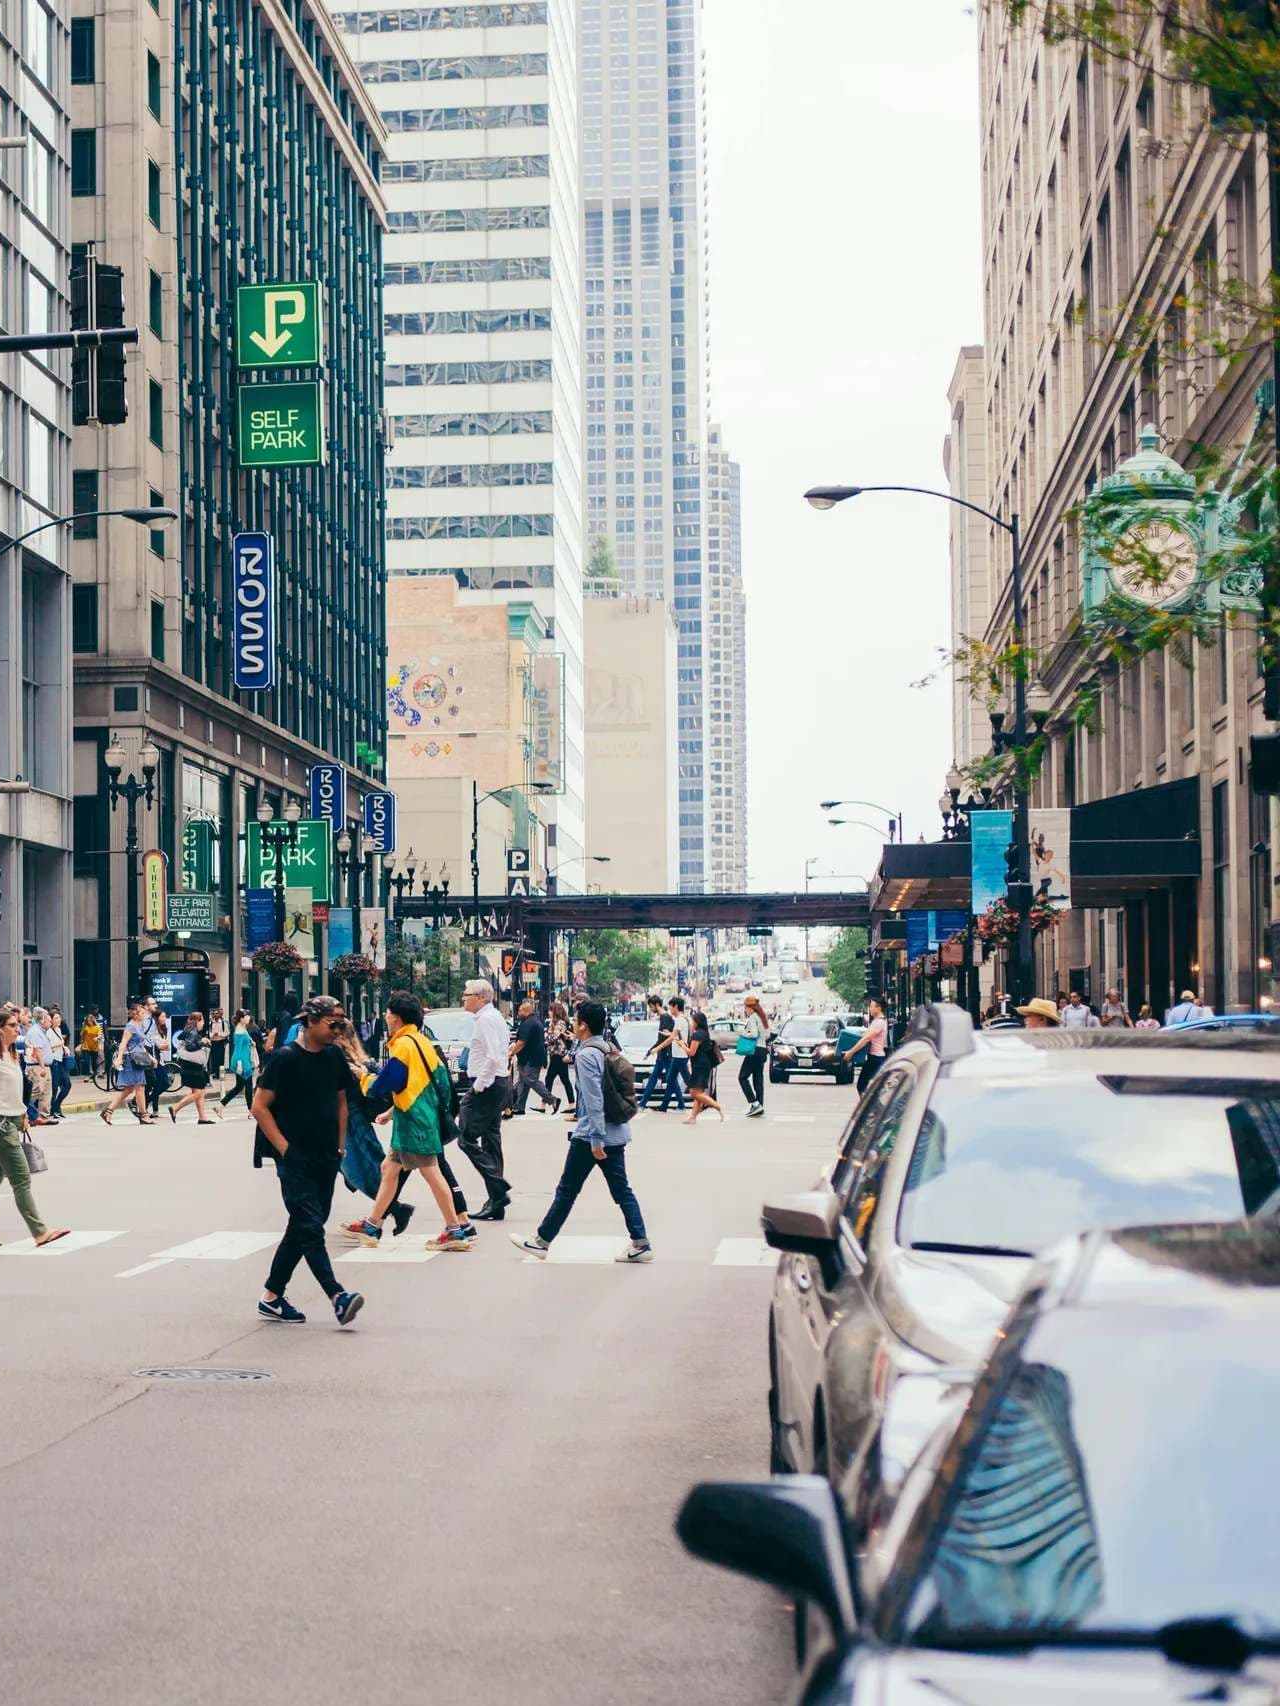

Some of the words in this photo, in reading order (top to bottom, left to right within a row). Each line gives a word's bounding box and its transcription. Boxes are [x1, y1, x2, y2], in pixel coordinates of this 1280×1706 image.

[250, 409, 300, 429] SELF
[250, 429, 307, 450] PARK
[237, 547, 266, 674] ROSS
[372, 796, 386, 851] ROSS
[259, 847, 317, 866] PARK
[169, 898, 191, 907] SELF
[192, 898, 211, 907] PARK
[171, 908, 210, 917] ELEVATOR
[169, 918, 211, 927] ENTRANCE
